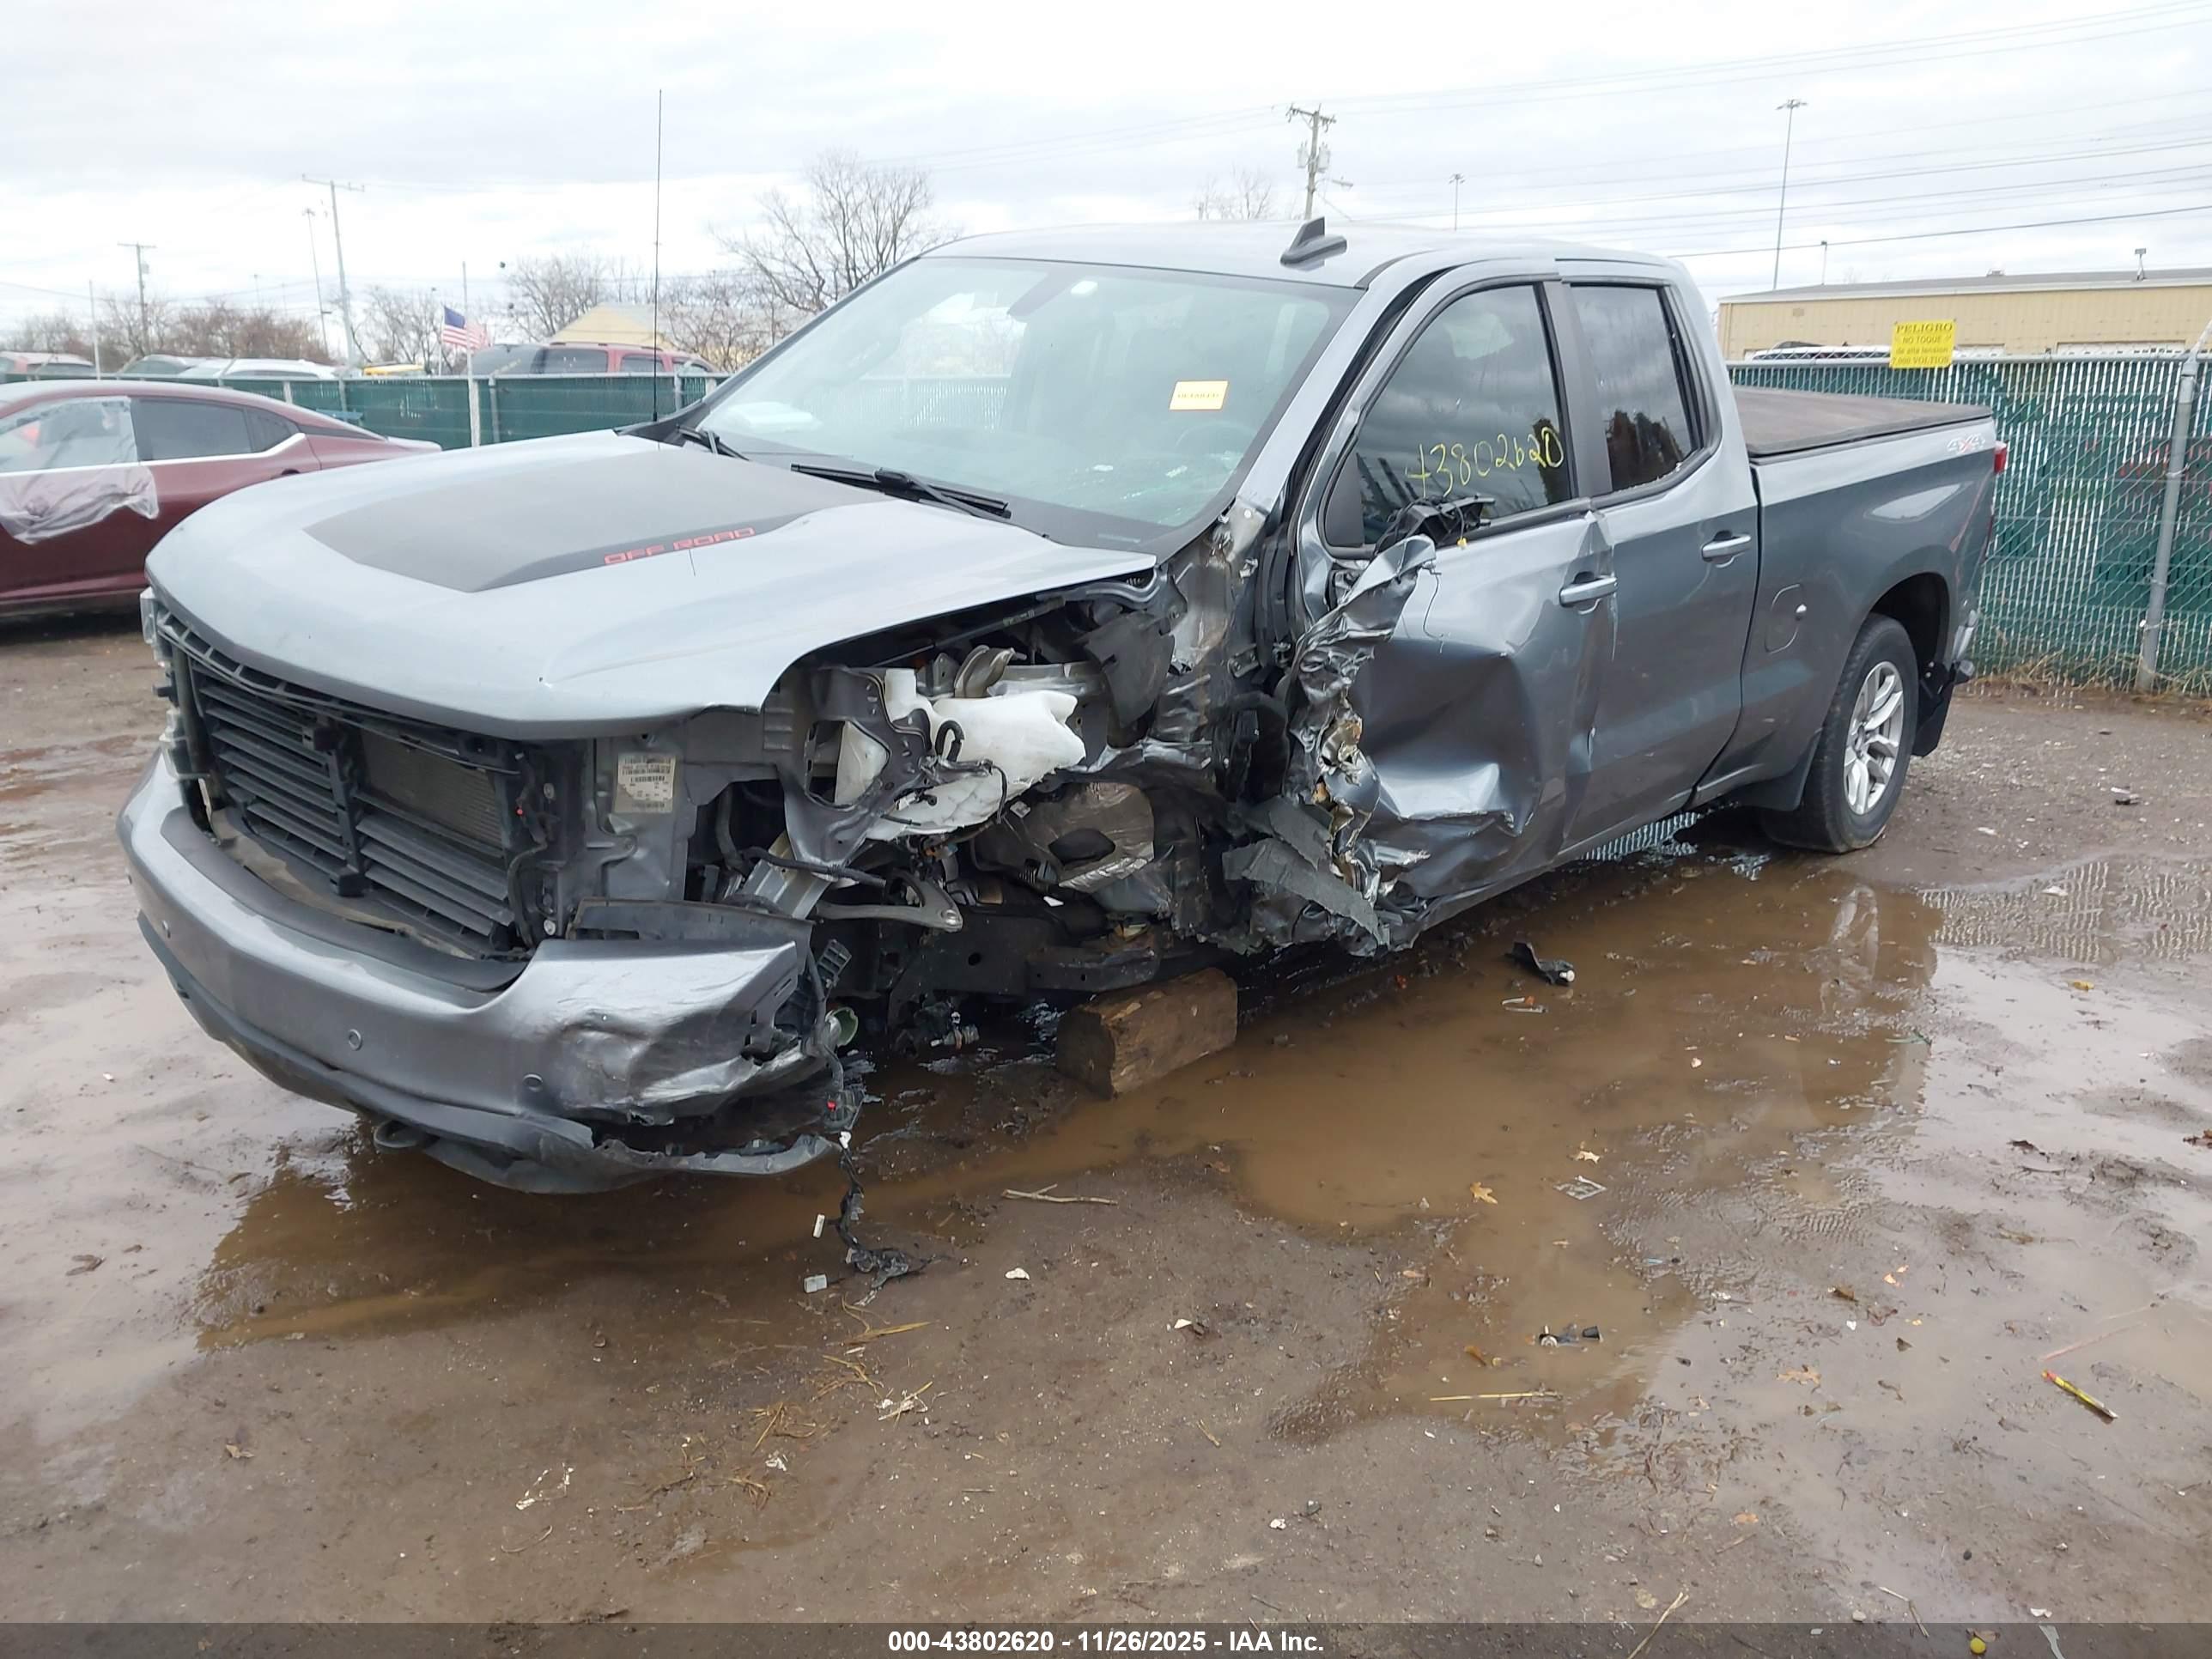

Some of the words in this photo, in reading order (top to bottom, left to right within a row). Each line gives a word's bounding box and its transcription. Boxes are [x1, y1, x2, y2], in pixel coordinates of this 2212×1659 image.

[1896, 323, 1953, 333] PELIGRO
[1917, 335, 1942, 343] TOQUE
[604, 544, 665, 565] OFF
[672, 526, 757, 551] ROAD
